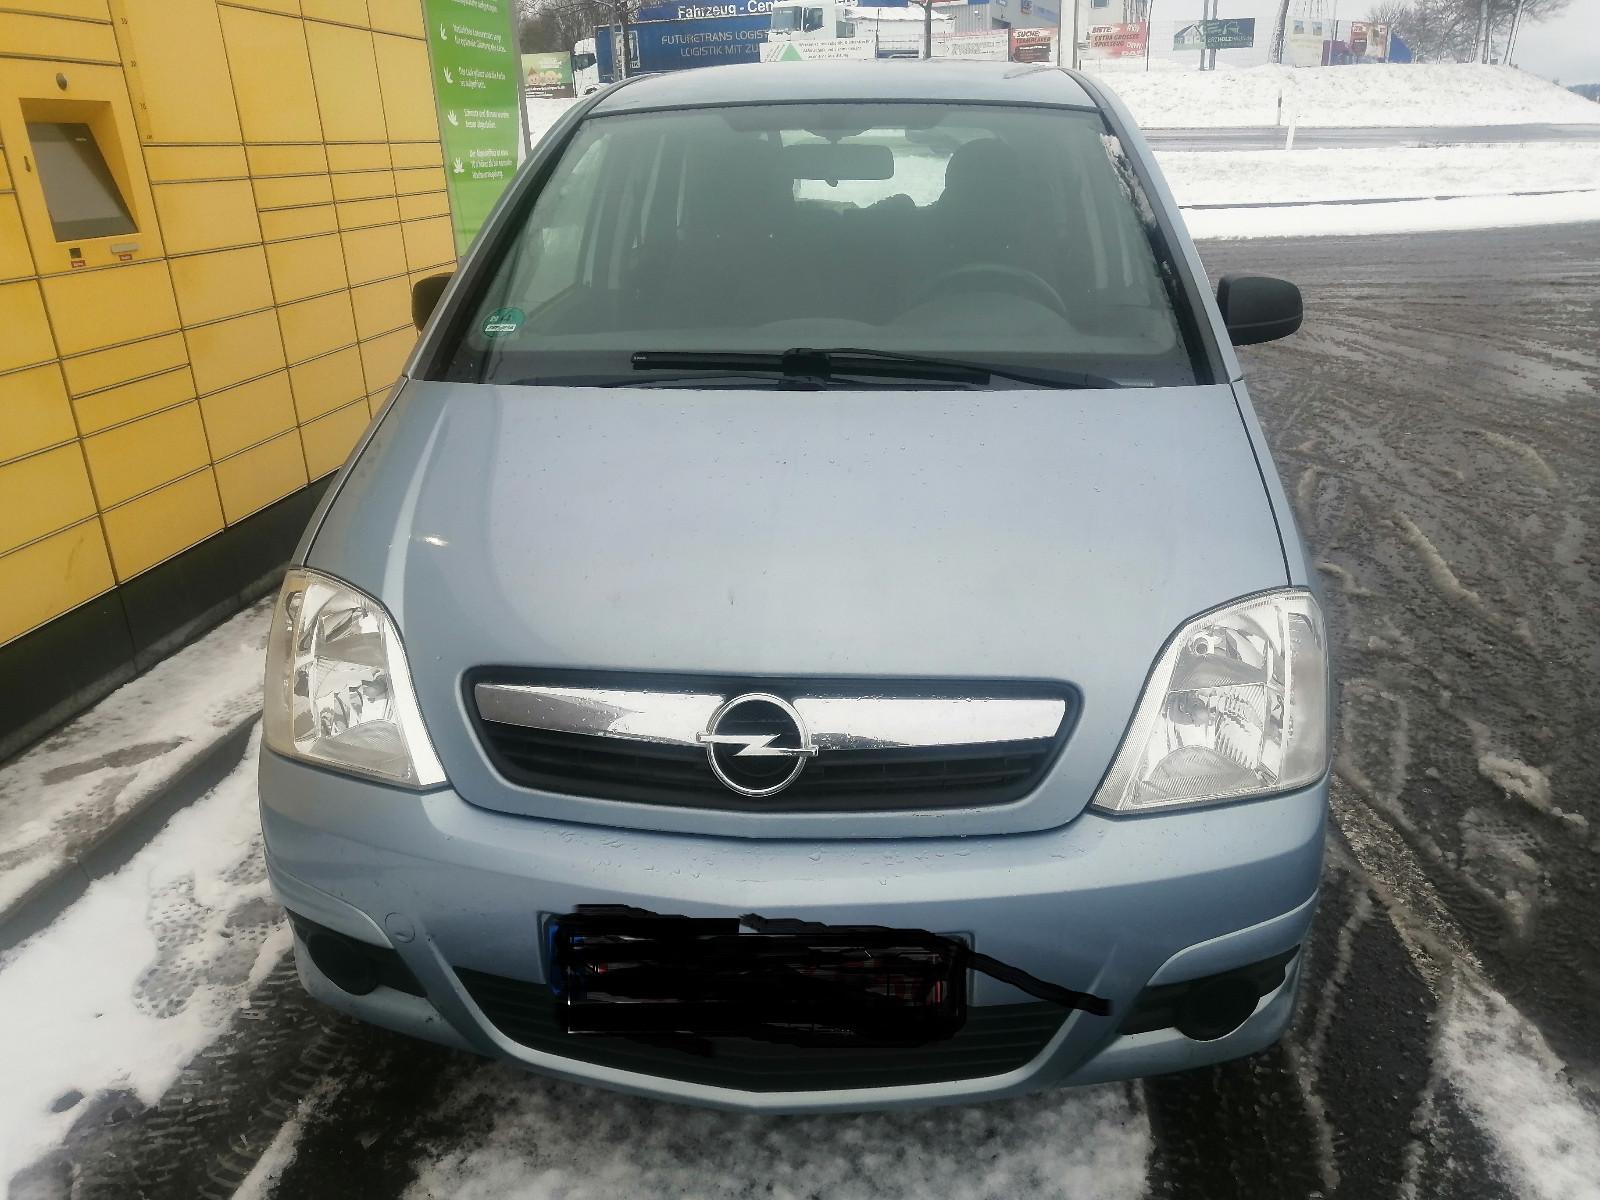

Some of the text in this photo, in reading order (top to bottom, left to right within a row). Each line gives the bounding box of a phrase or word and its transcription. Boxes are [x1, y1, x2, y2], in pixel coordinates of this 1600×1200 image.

[677, 4, 736, 19] Fahrzeug
[747, 0, 774, 13] Cen
[661, 29, 769, 45] FUTURETRANS LOGIST
[1016, 30, 1041, 38] SUCHE:
[680, 45, 722, 57] LOGISTIK
[724, 44, 744, 55] MIT
